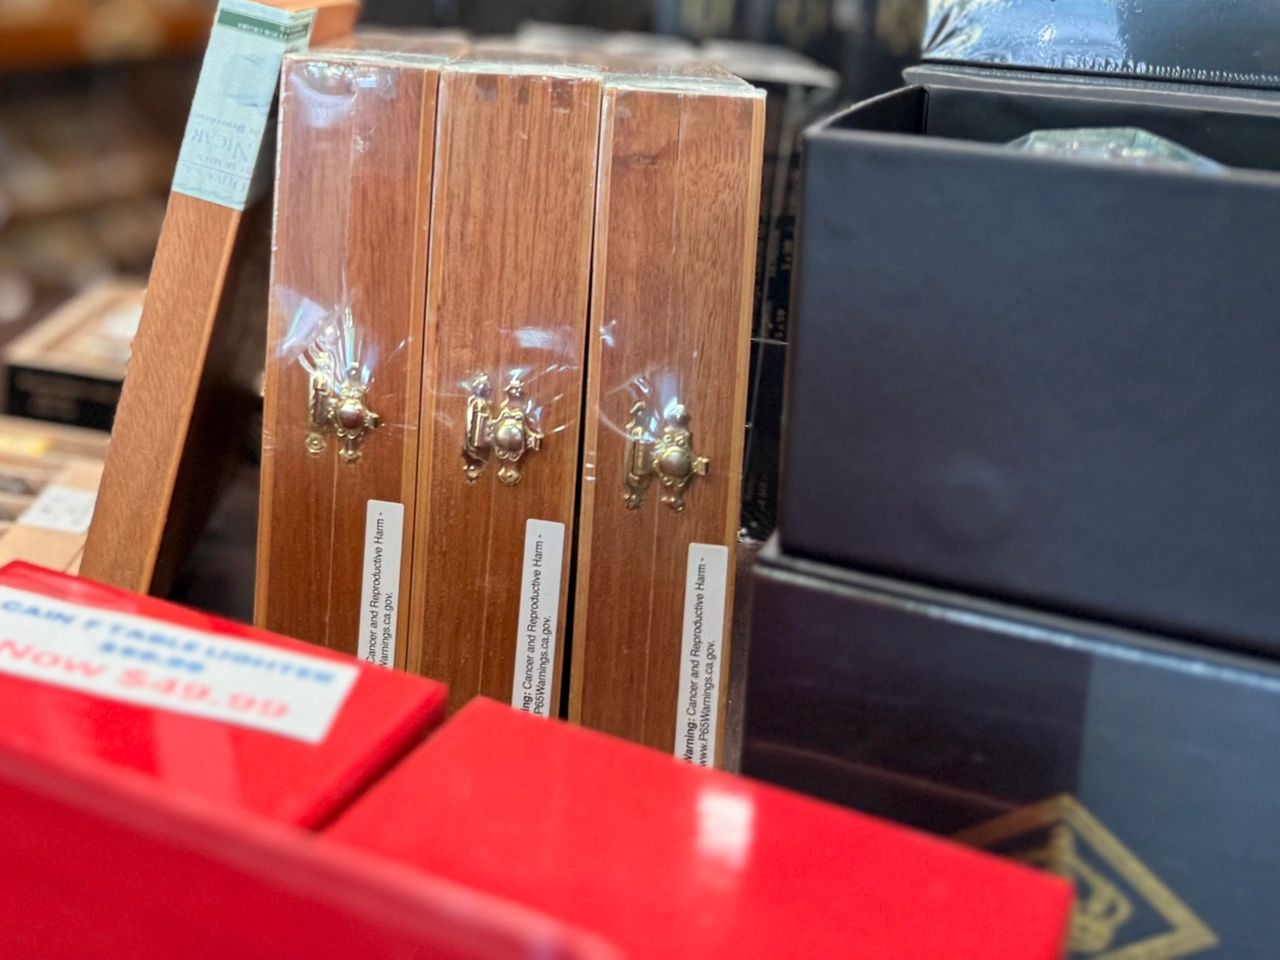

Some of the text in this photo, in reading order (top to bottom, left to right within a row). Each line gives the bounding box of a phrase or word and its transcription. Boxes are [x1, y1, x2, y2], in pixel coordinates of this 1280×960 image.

[373, 519, 384, 545] Harm
[533, 541, 543, 567] Harm
[369, 547, 383, 608] Reproductive
[694, 564, 706, 591] Harm
[527, 570, 541, 633] Reproductive
[368, 611, 378, 628] and
[690, 593, 705, 657] Reproductive
[0, 599, 74, 626] CAIN
[107, 622, 198, 653] TABLE
[206, 644, 338, 685] LIGHTER
[365, 631, 377, 664] Cancer
[525, 635, 536, 653] and
[522, 656, 534, 690] Cancer
[688, 660, 699, 678] and
[116, 671, 289, 719] $49.99
[686, 681, 698, 716] Cancer
